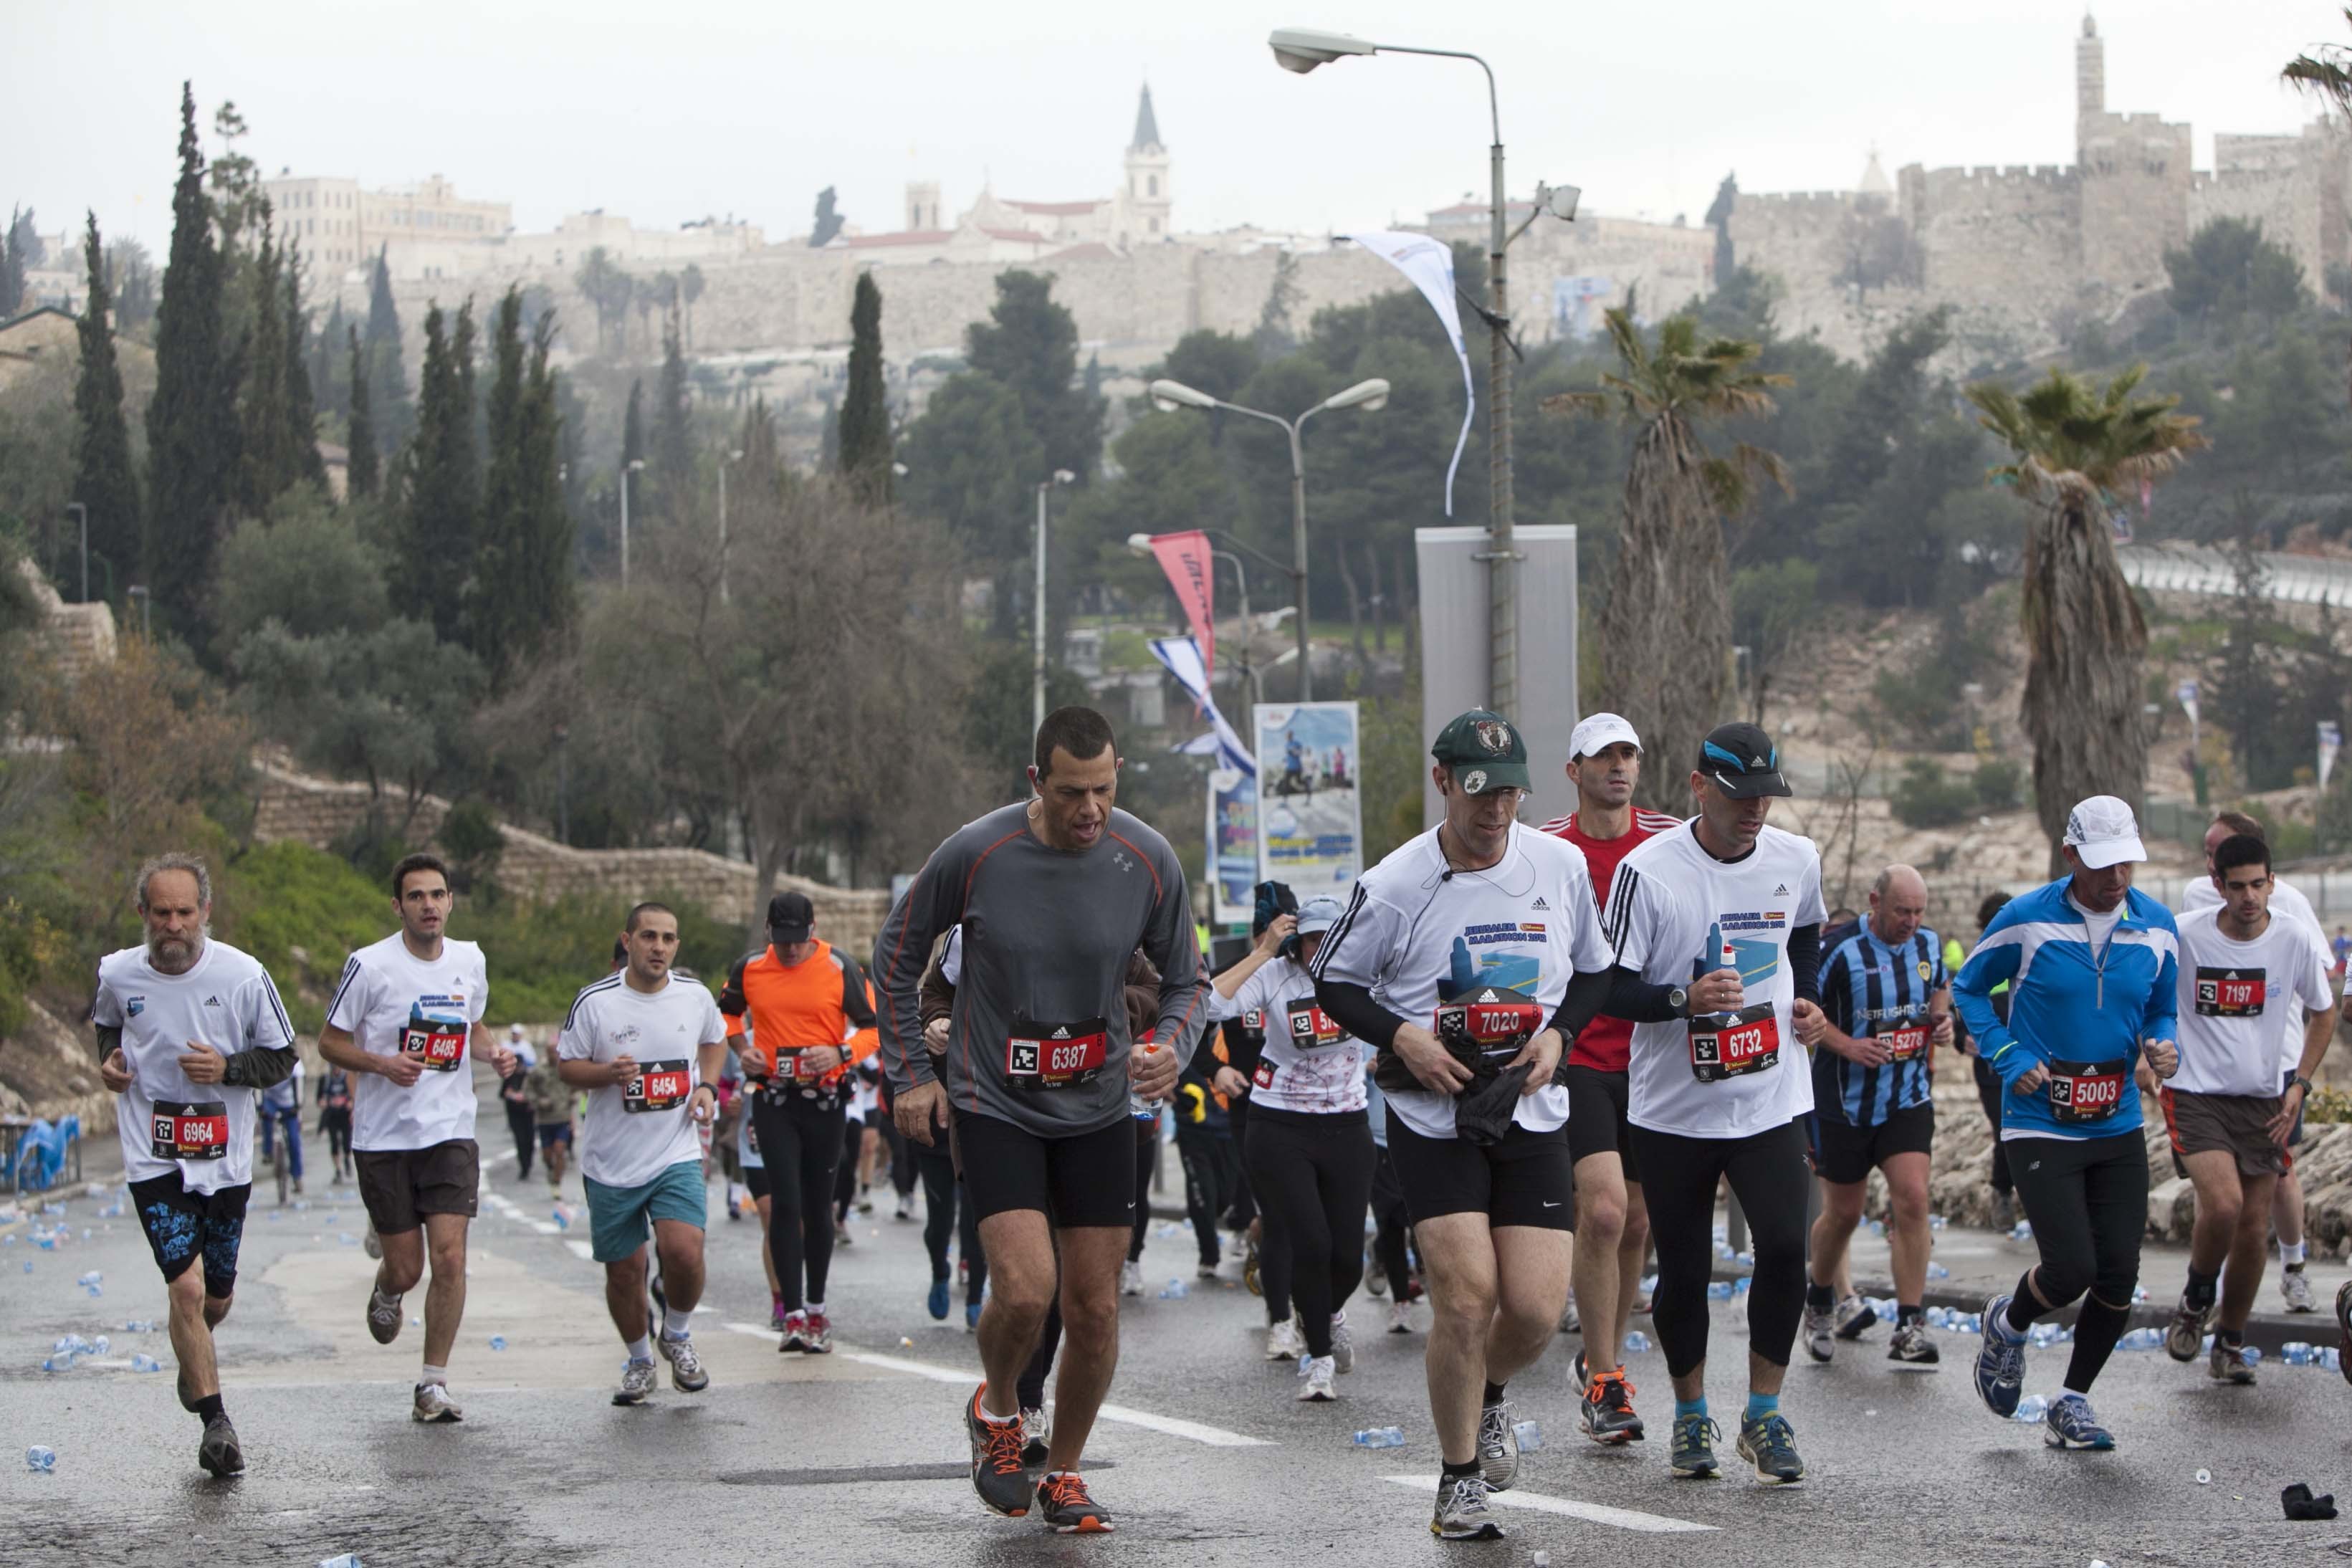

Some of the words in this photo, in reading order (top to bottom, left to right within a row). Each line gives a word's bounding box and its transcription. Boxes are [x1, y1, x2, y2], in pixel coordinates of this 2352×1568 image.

[1720, 912, 1761, 923] JERUSALEM
[1721, 922, 1769, 930] MARATHON
[1464, 923, 1517, 937] JERUSALEM
[1468, 932, 1527, 945] MARATHON
[1528, 933, 1547, 942] 2012
[2225, 985, 2252, 1003] 7197
[1857, 1003, 1916, 1020] NETFLIGHTS
[1481, 1011, 1519, 1033] 7020
[1768, 1019, 1774, 1031] B
[432, 1038, 457, 1058] 6485
[1729, 1028, 1763, 1057] 6732
[1896, 1031, 1923, 1050] 5278
[1051, 1043, 1088, 1070] 6387
[651, 1076, 677, 1096] 6454
[2076, 1080, 2116, 1103] 5003
[183, 1122, 214, 1142] 6964
